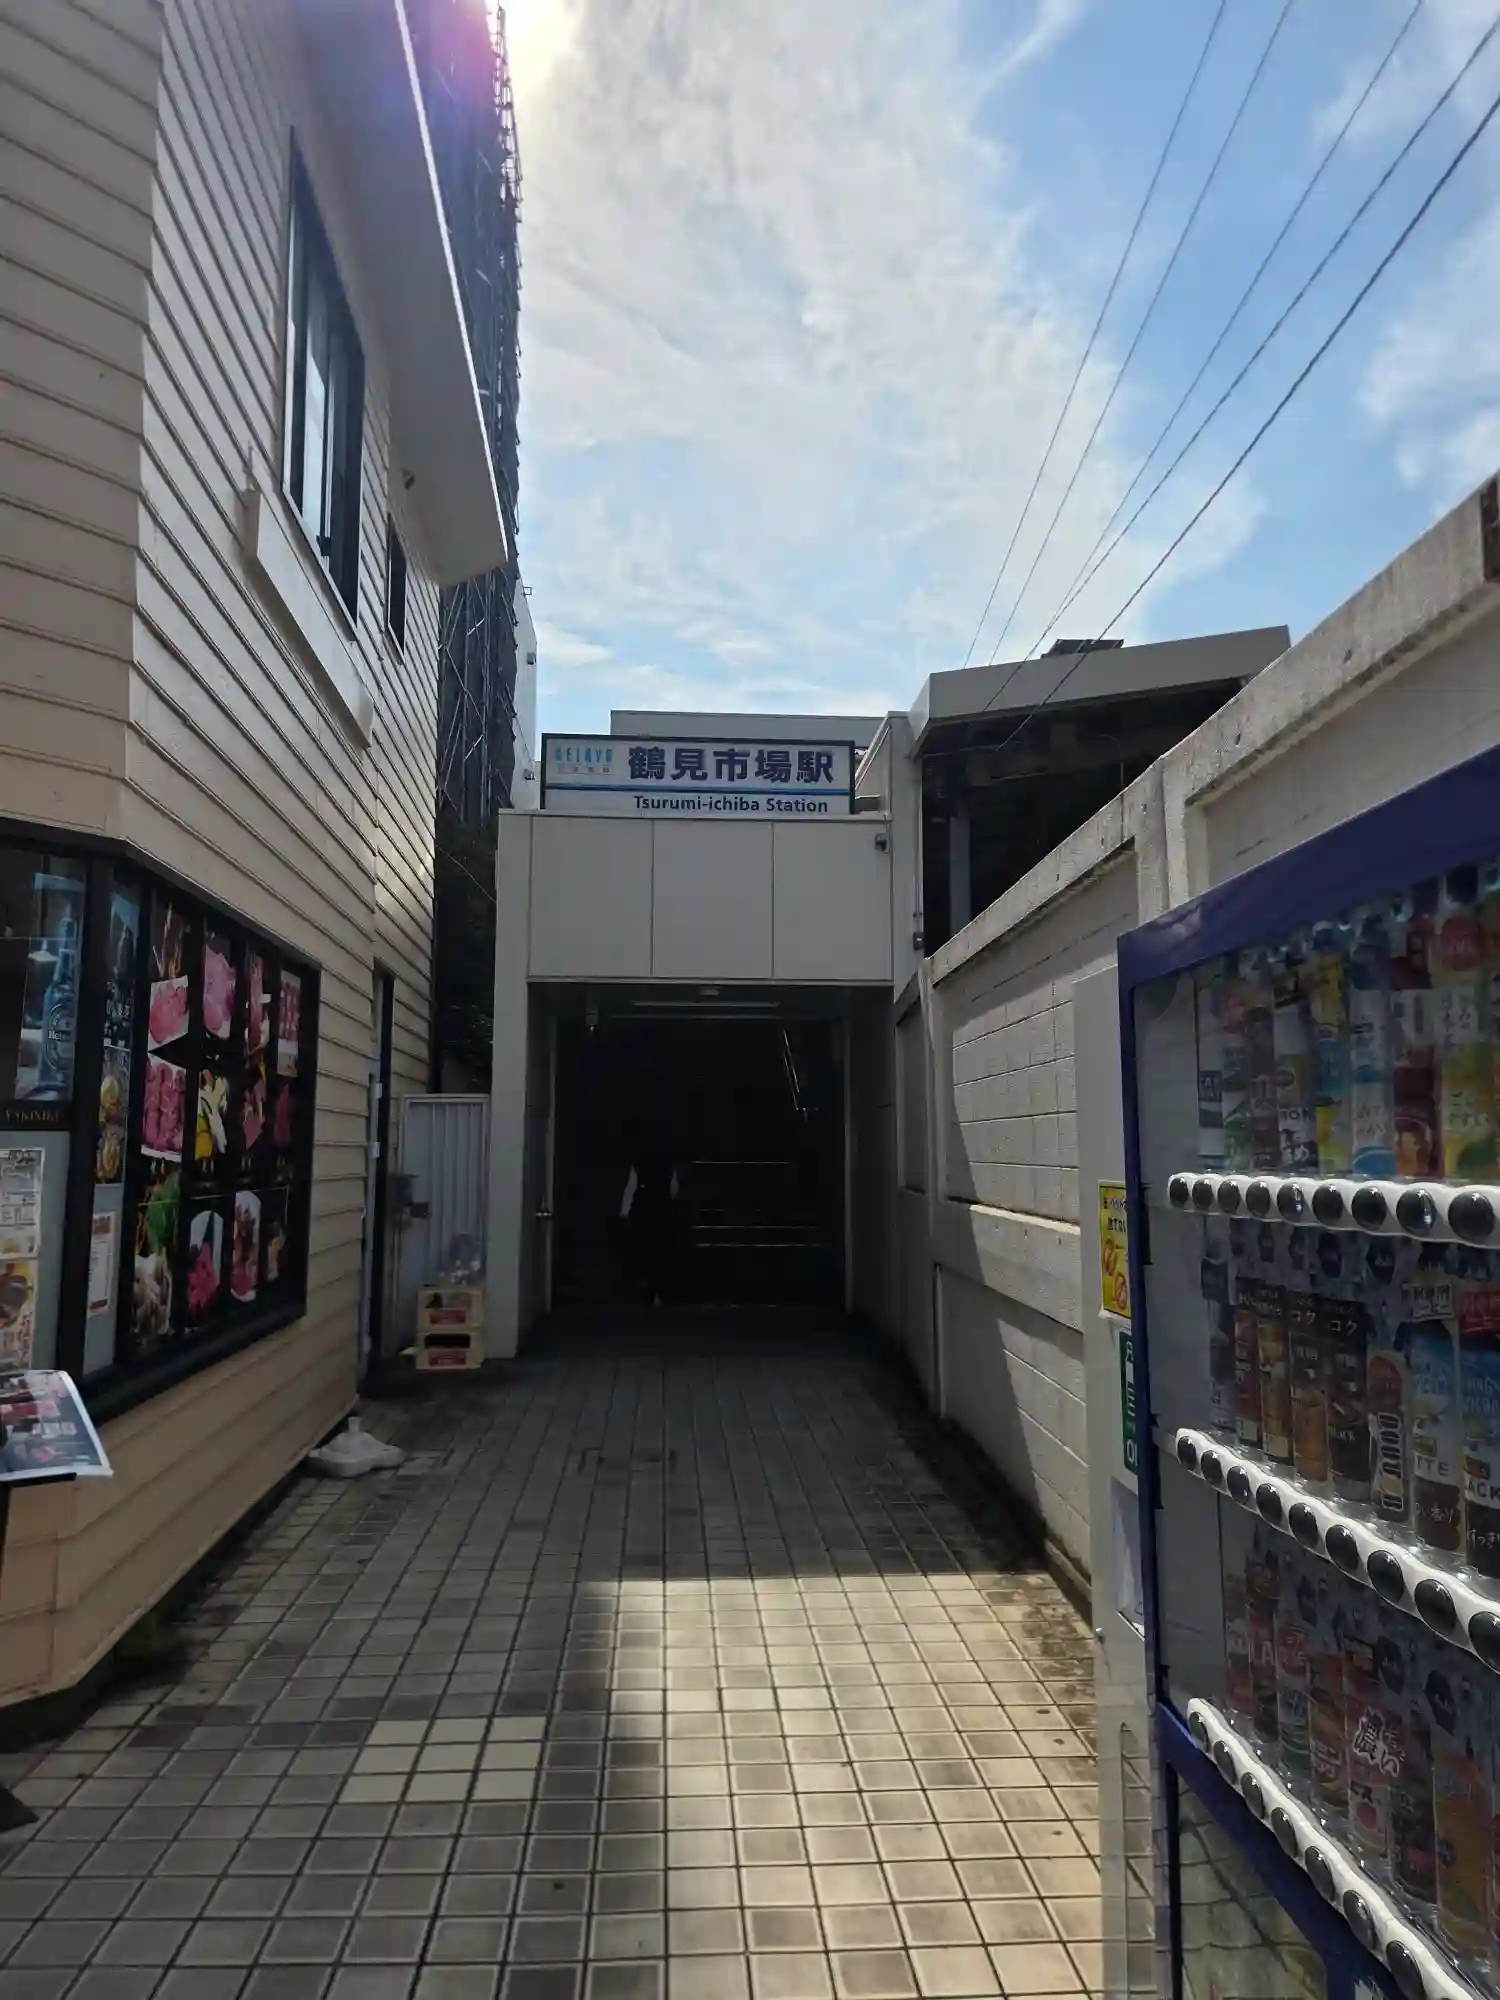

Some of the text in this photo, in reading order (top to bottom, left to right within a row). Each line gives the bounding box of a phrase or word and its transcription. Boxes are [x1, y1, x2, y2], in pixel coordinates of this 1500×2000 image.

[628, 745, 834, 783] 鶴見市場駅
[633, 795, 828, 813] Tsurumi-ichiba Station
[1329, 1319, 1357, 1336] コク
